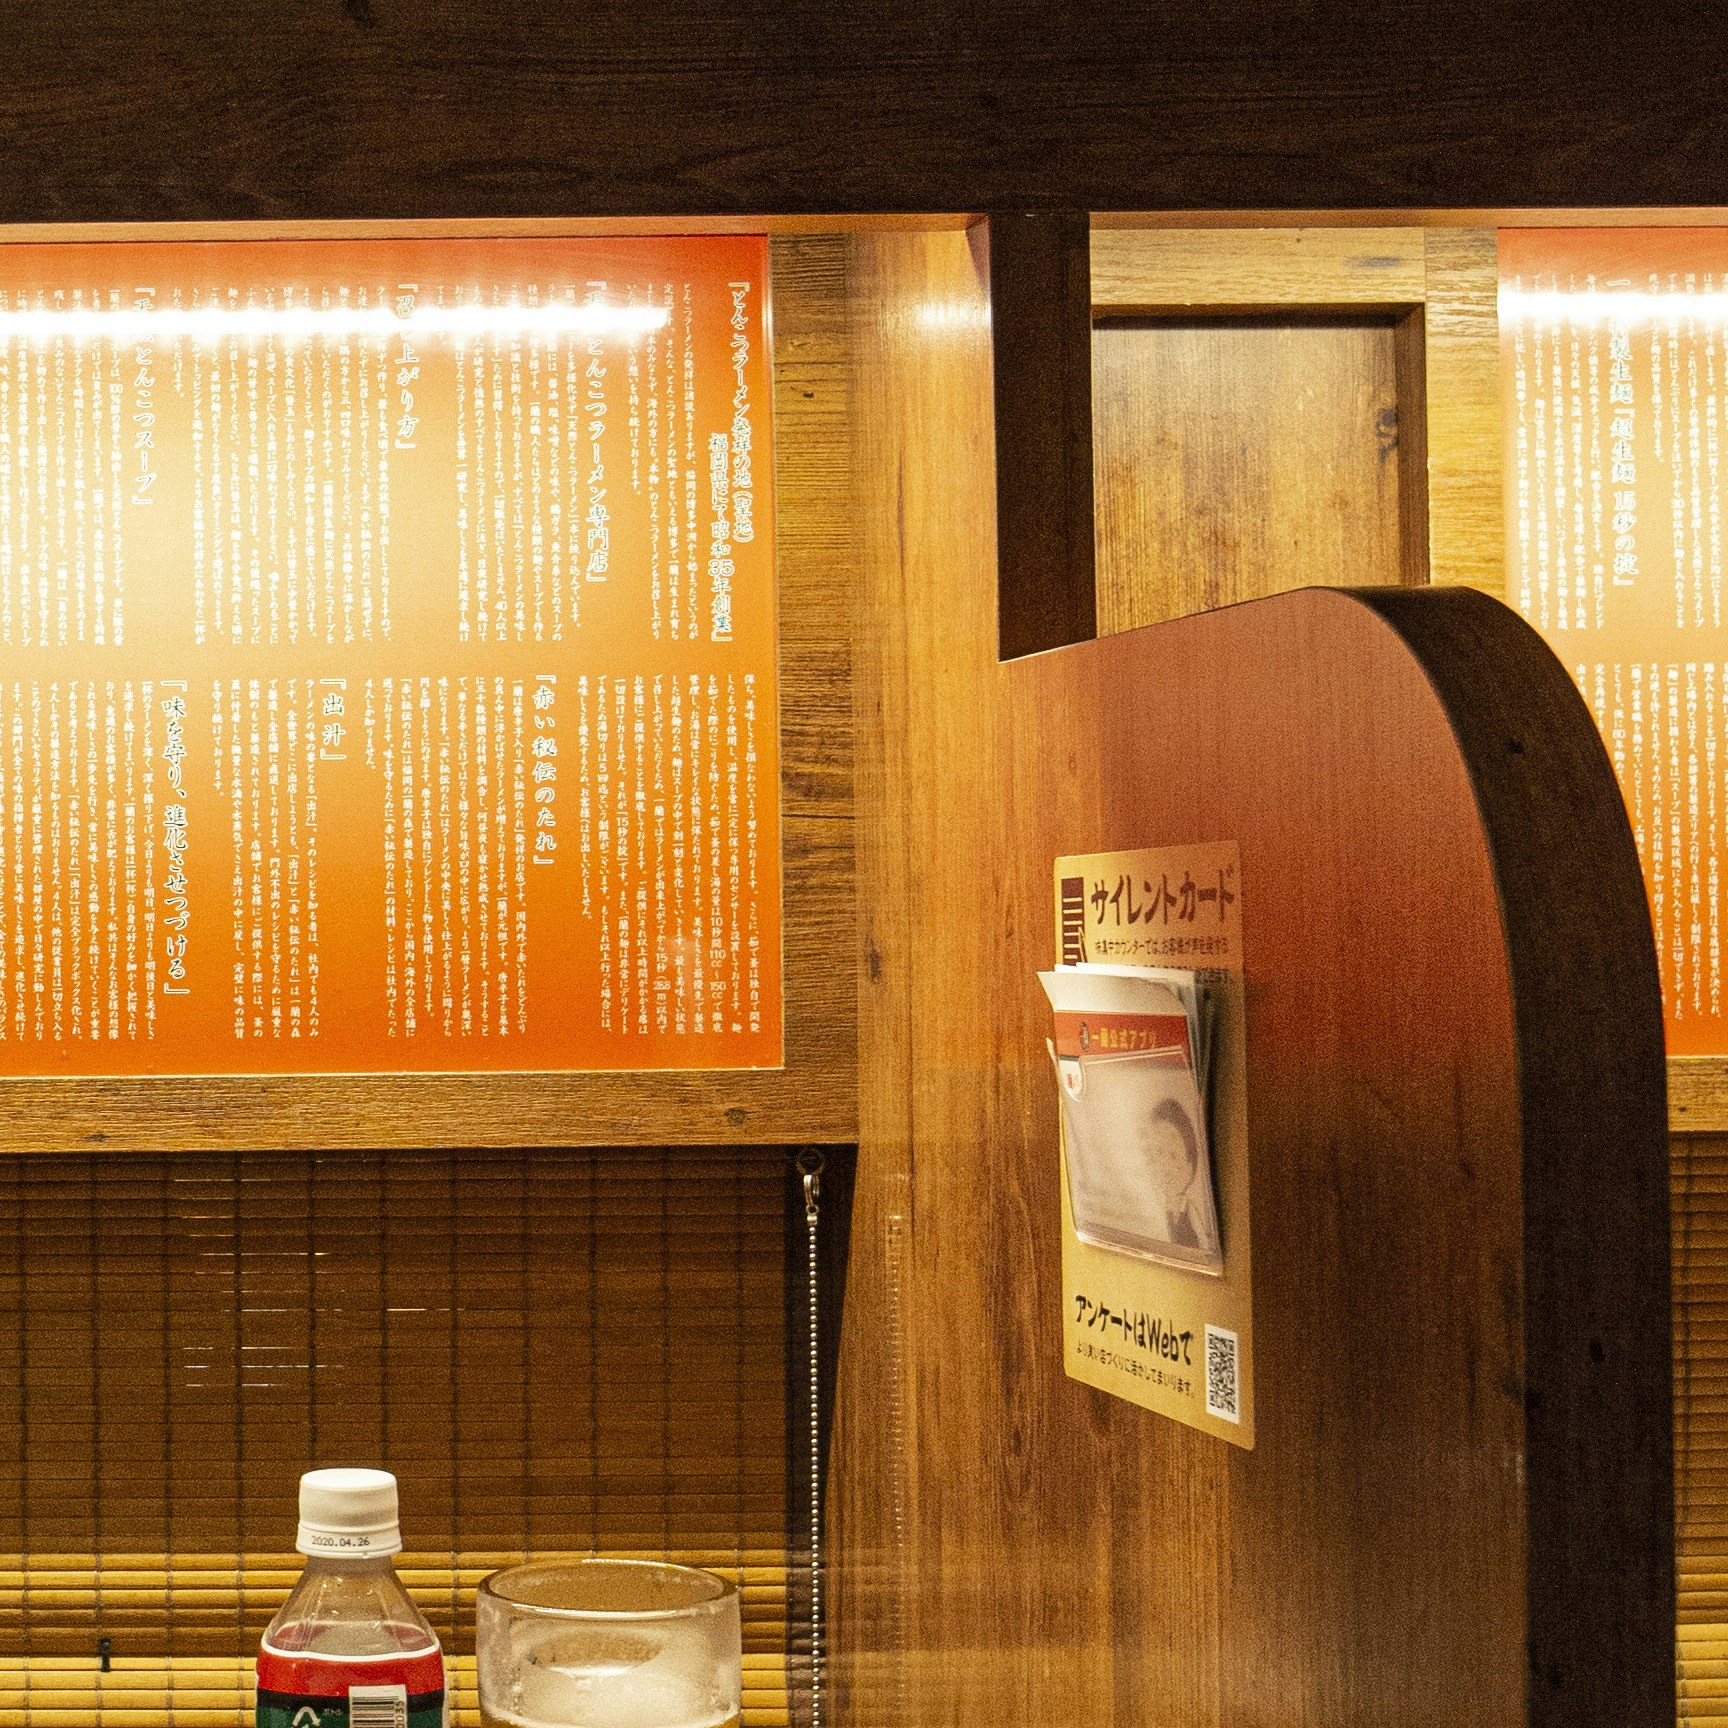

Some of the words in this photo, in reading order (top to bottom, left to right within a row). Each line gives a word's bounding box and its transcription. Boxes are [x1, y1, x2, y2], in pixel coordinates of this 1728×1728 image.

[132, 288, 157, 505] 『天とんこつスープ』
[585, 281, 609, 583] 『天とんこつラーメン専門店』
[319, 679, 347, 761] 『出汁』
[532, 674, 557, 865] 『赤い秘伝のたれ』
[160, 680, 190, 994] 『味を守り、進化させつづける』
[1091, 866, 1235, 926] サイレントカード
[311, 1536, 371, 1547] 2020.04.26
